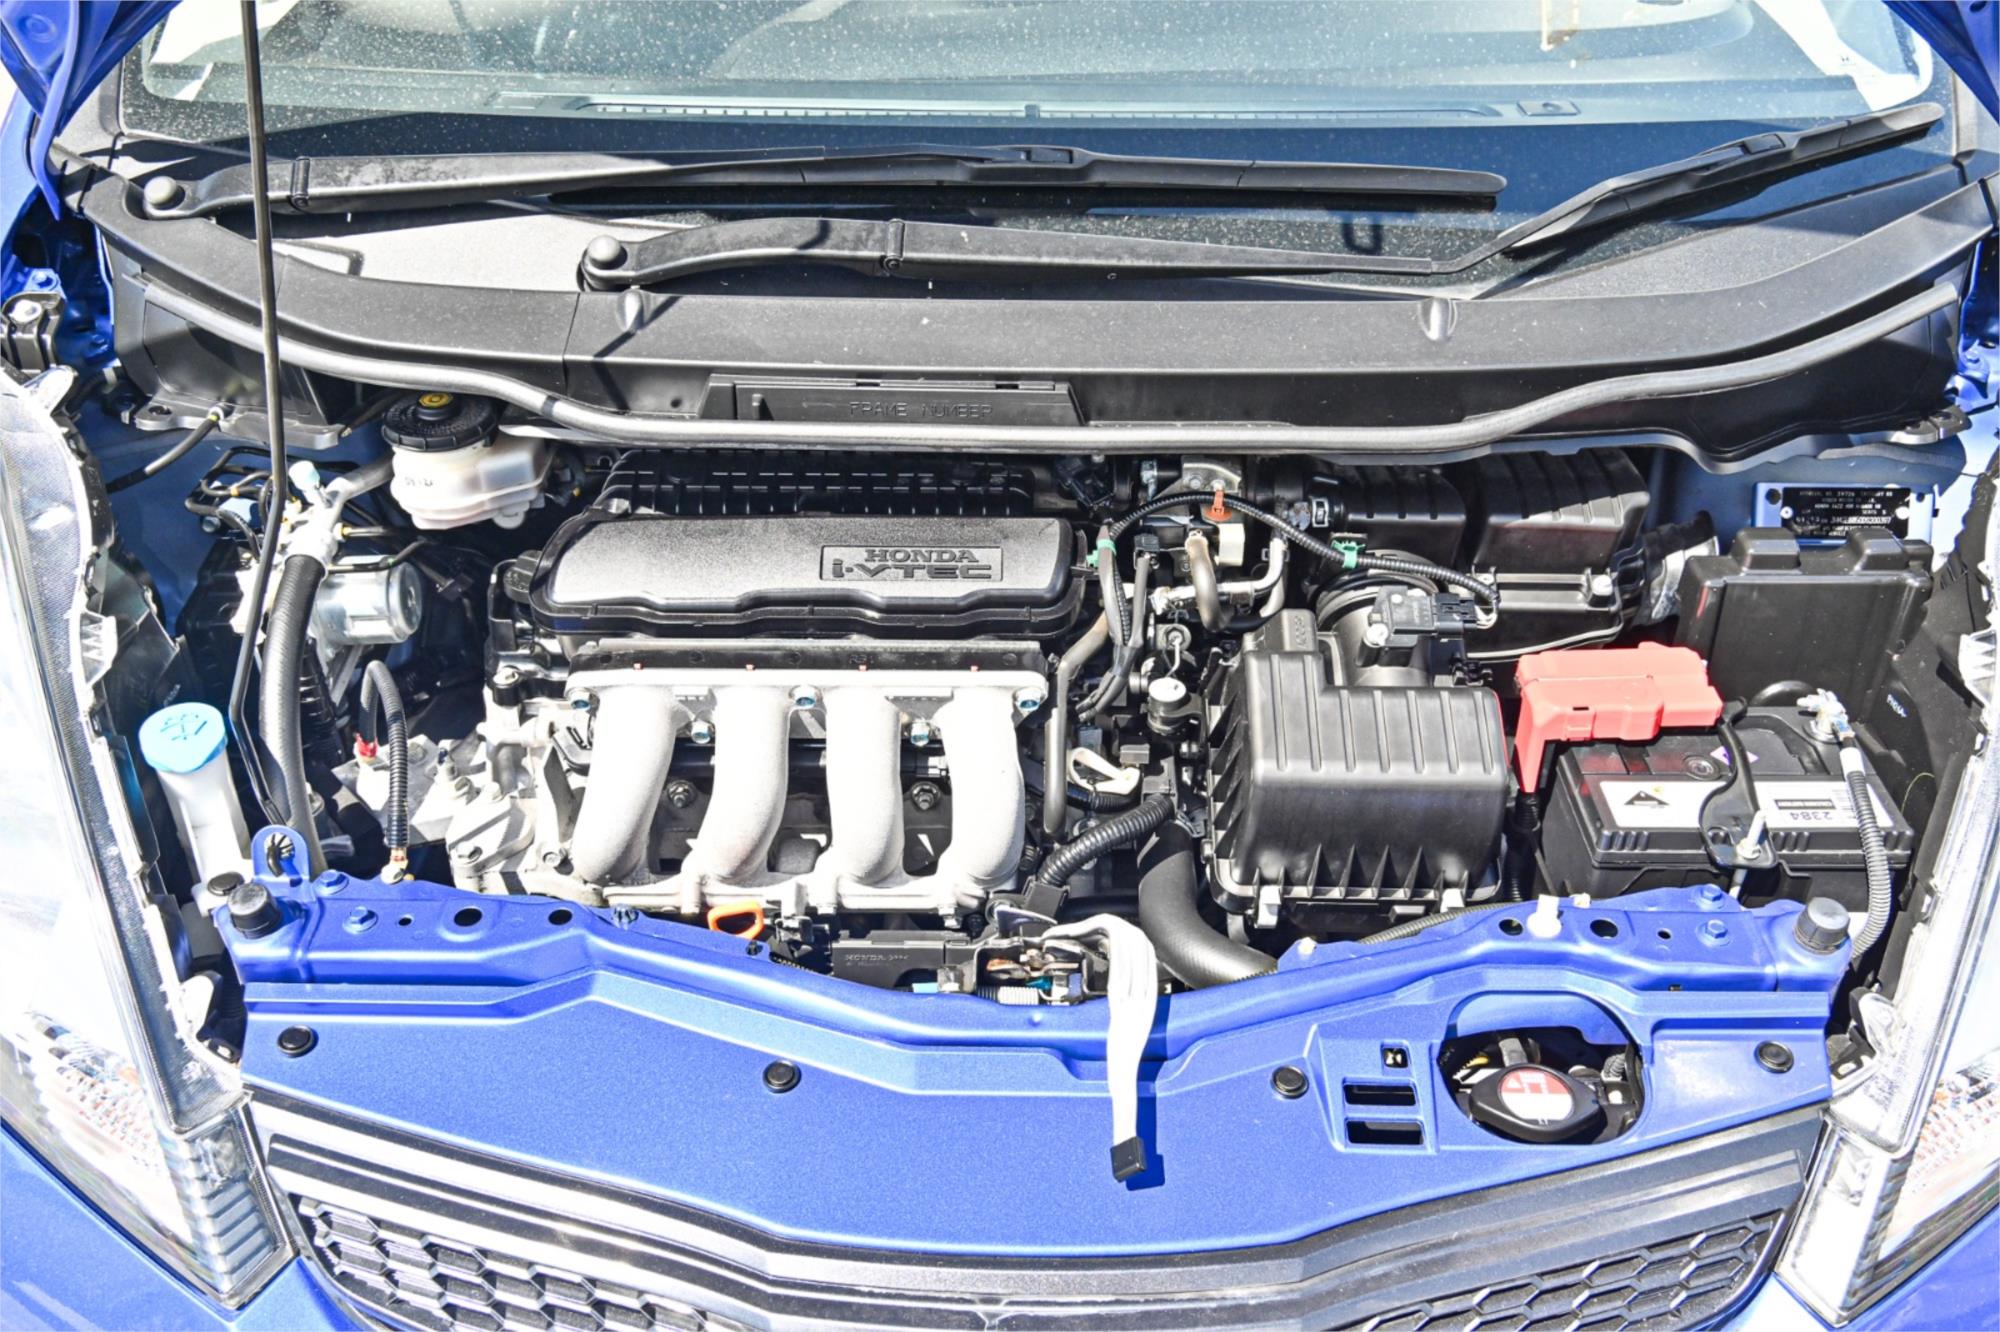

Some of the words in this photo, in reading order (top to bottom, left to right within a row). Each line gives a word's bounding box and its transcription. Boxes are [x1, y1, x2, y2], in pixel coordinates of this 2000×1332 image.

[849, 401, 908, 417] FRAME
[921, 402, 993, 418] NUMBER
[864, 550, 980, 563] HONDA
[1790, 811, 1832, 820] 2384
